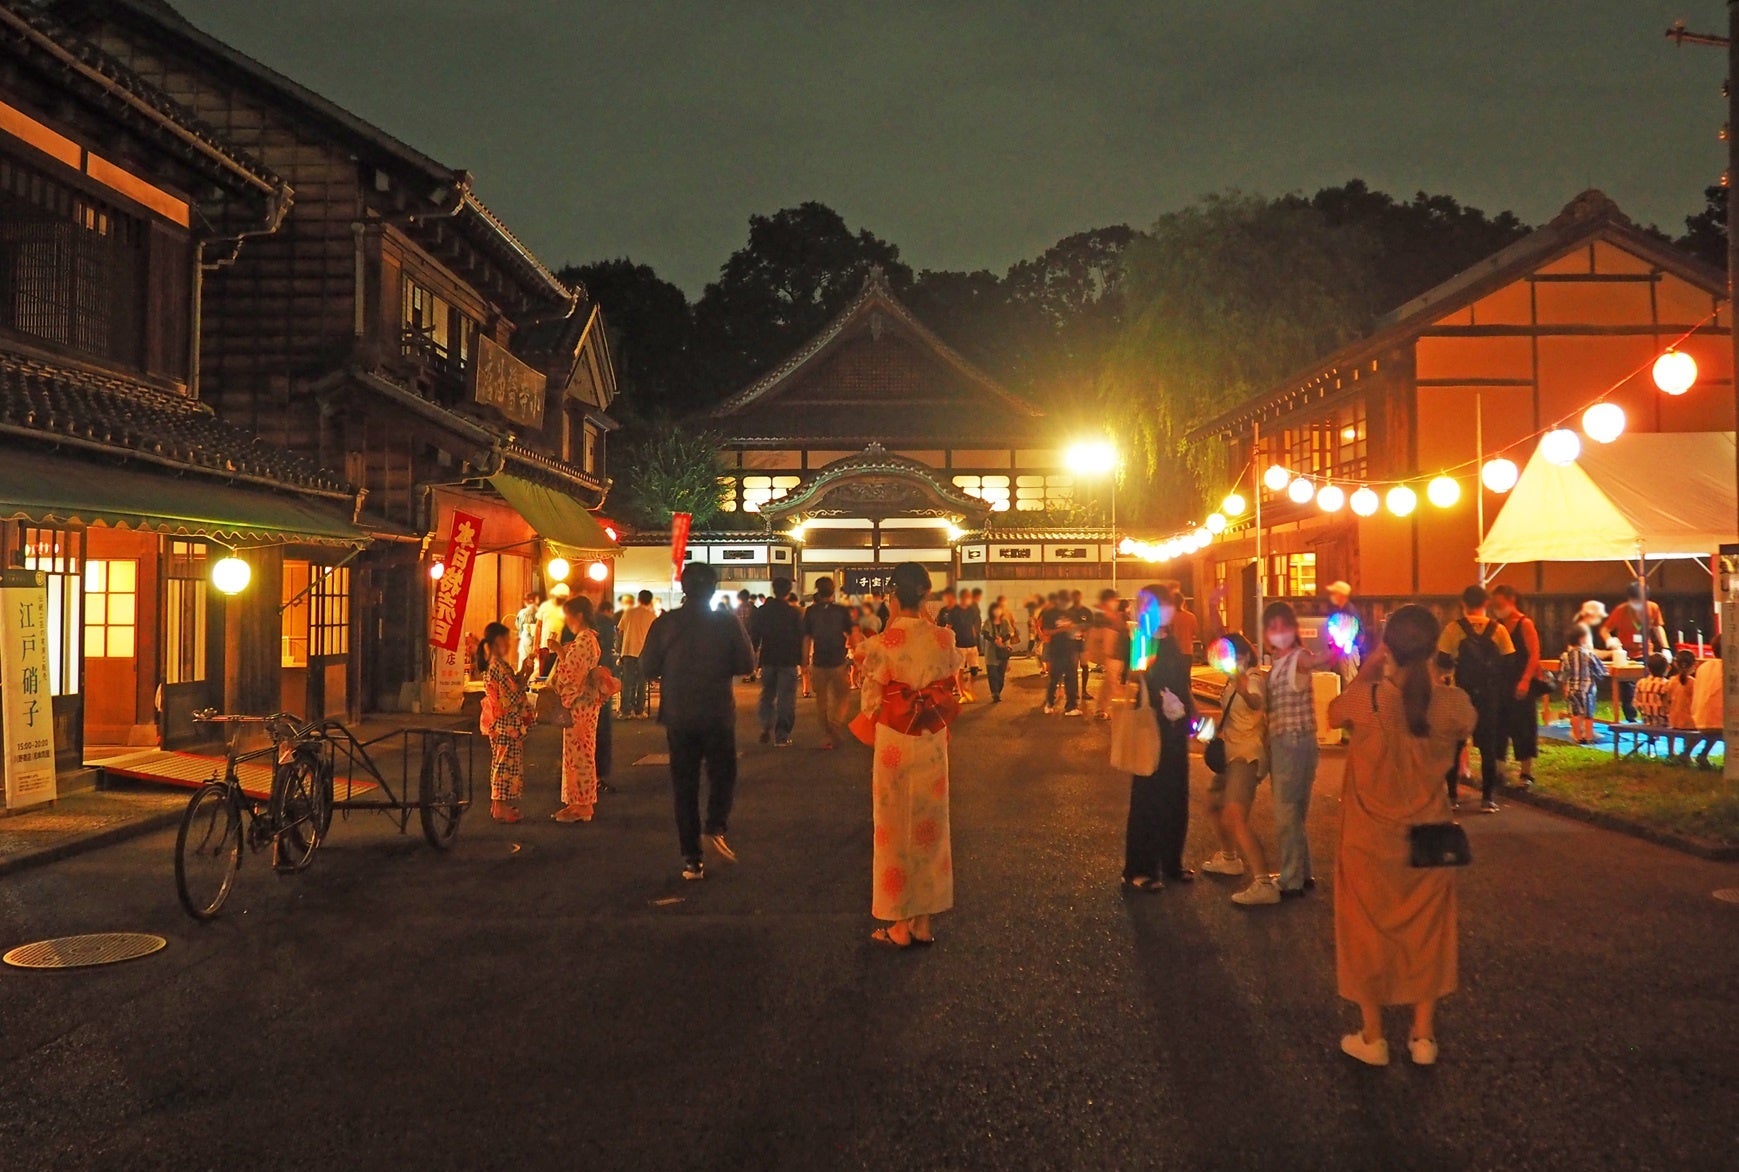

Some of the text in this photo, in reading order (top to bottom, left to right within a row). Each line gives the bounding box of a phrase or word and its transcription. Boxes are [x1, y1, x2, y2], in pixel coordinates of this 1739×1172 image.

[859, 576, 896, 587] 子宝
[20, 602, 39, 727] 江戸硝子
